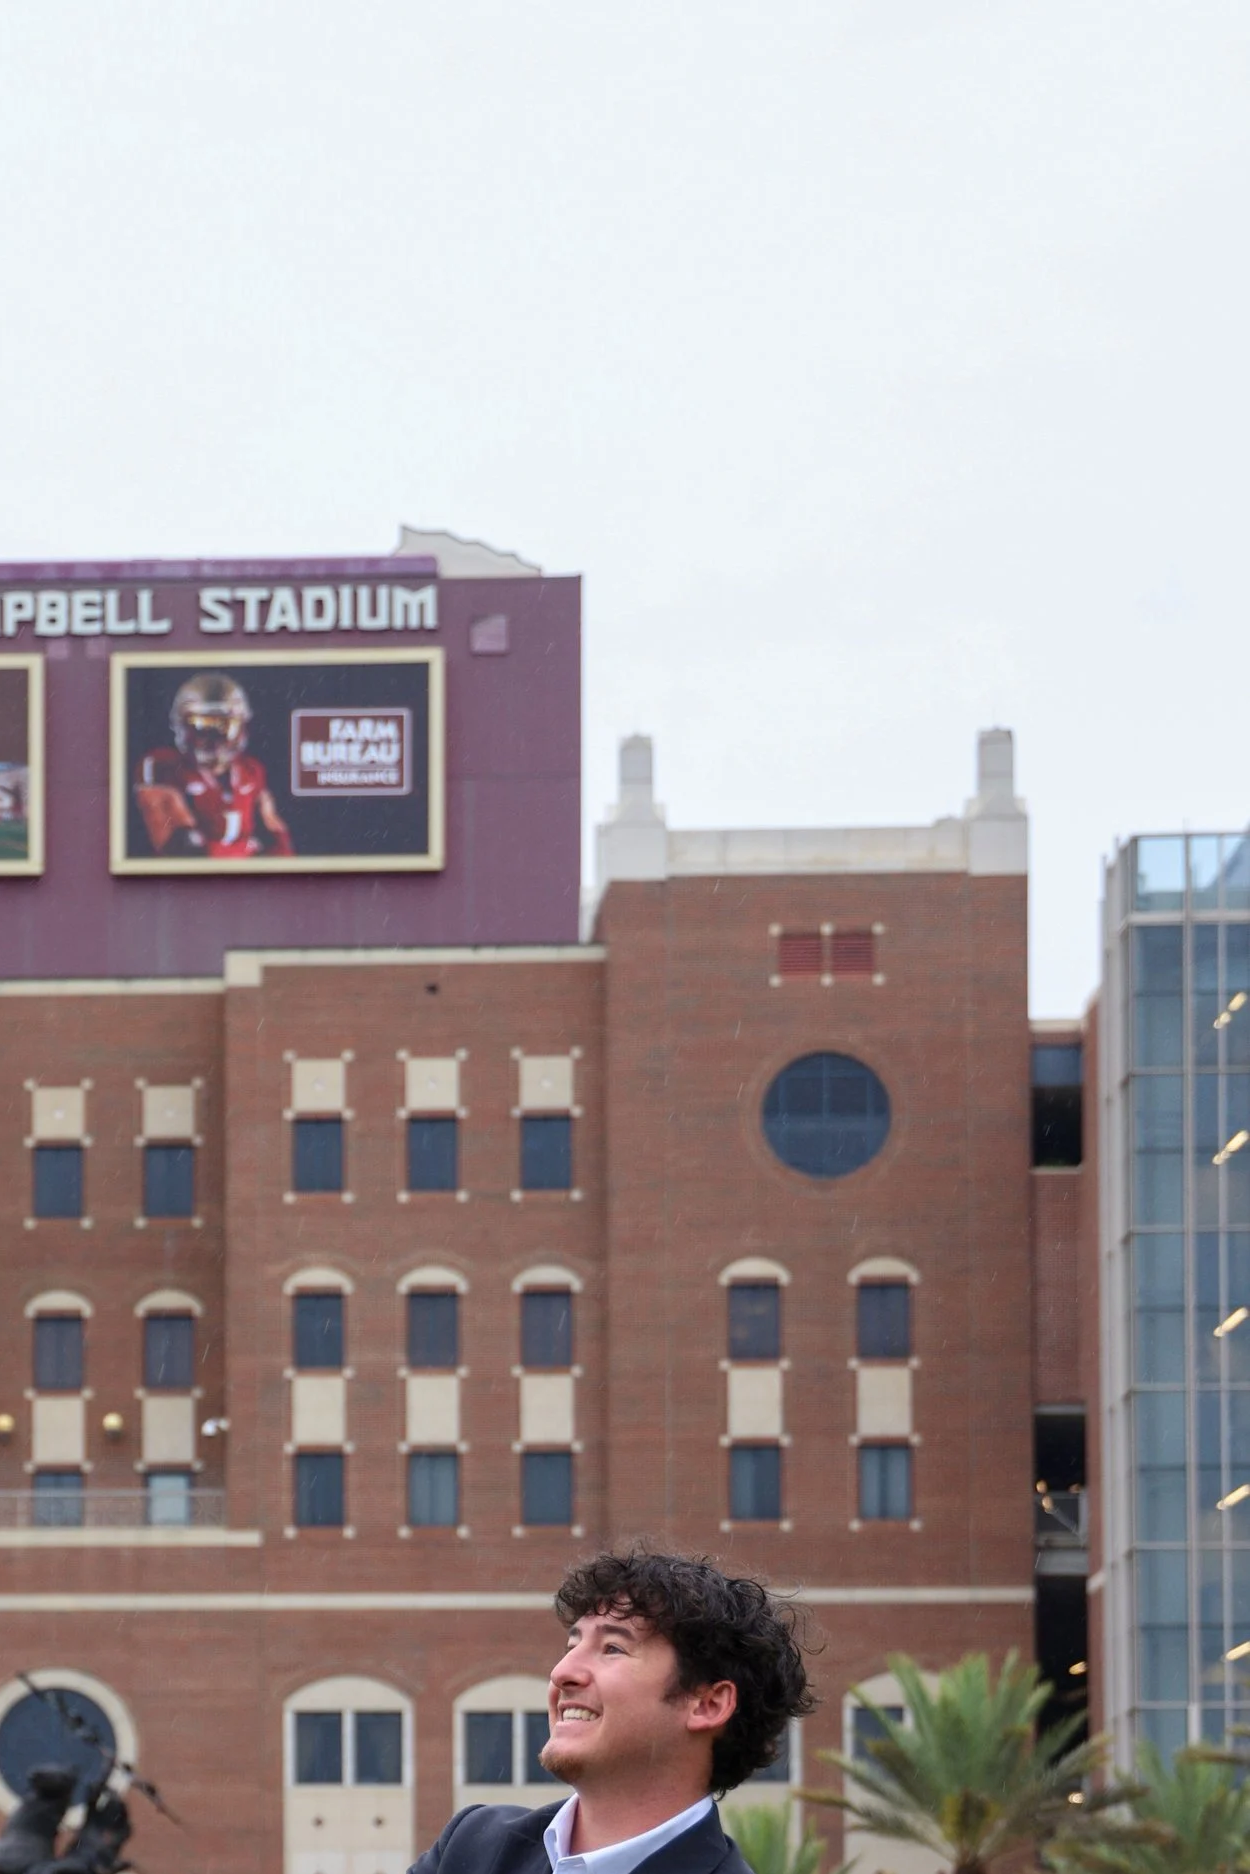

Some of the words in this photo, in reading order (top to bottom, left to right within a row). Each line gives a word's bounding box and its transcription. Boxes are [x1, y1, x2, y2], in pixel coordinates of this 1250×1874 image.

[199, 584, 438, 632] STADIUM
[330, 718, 399, 742] FARM
[301, 741, 400, 766] BUREAU
